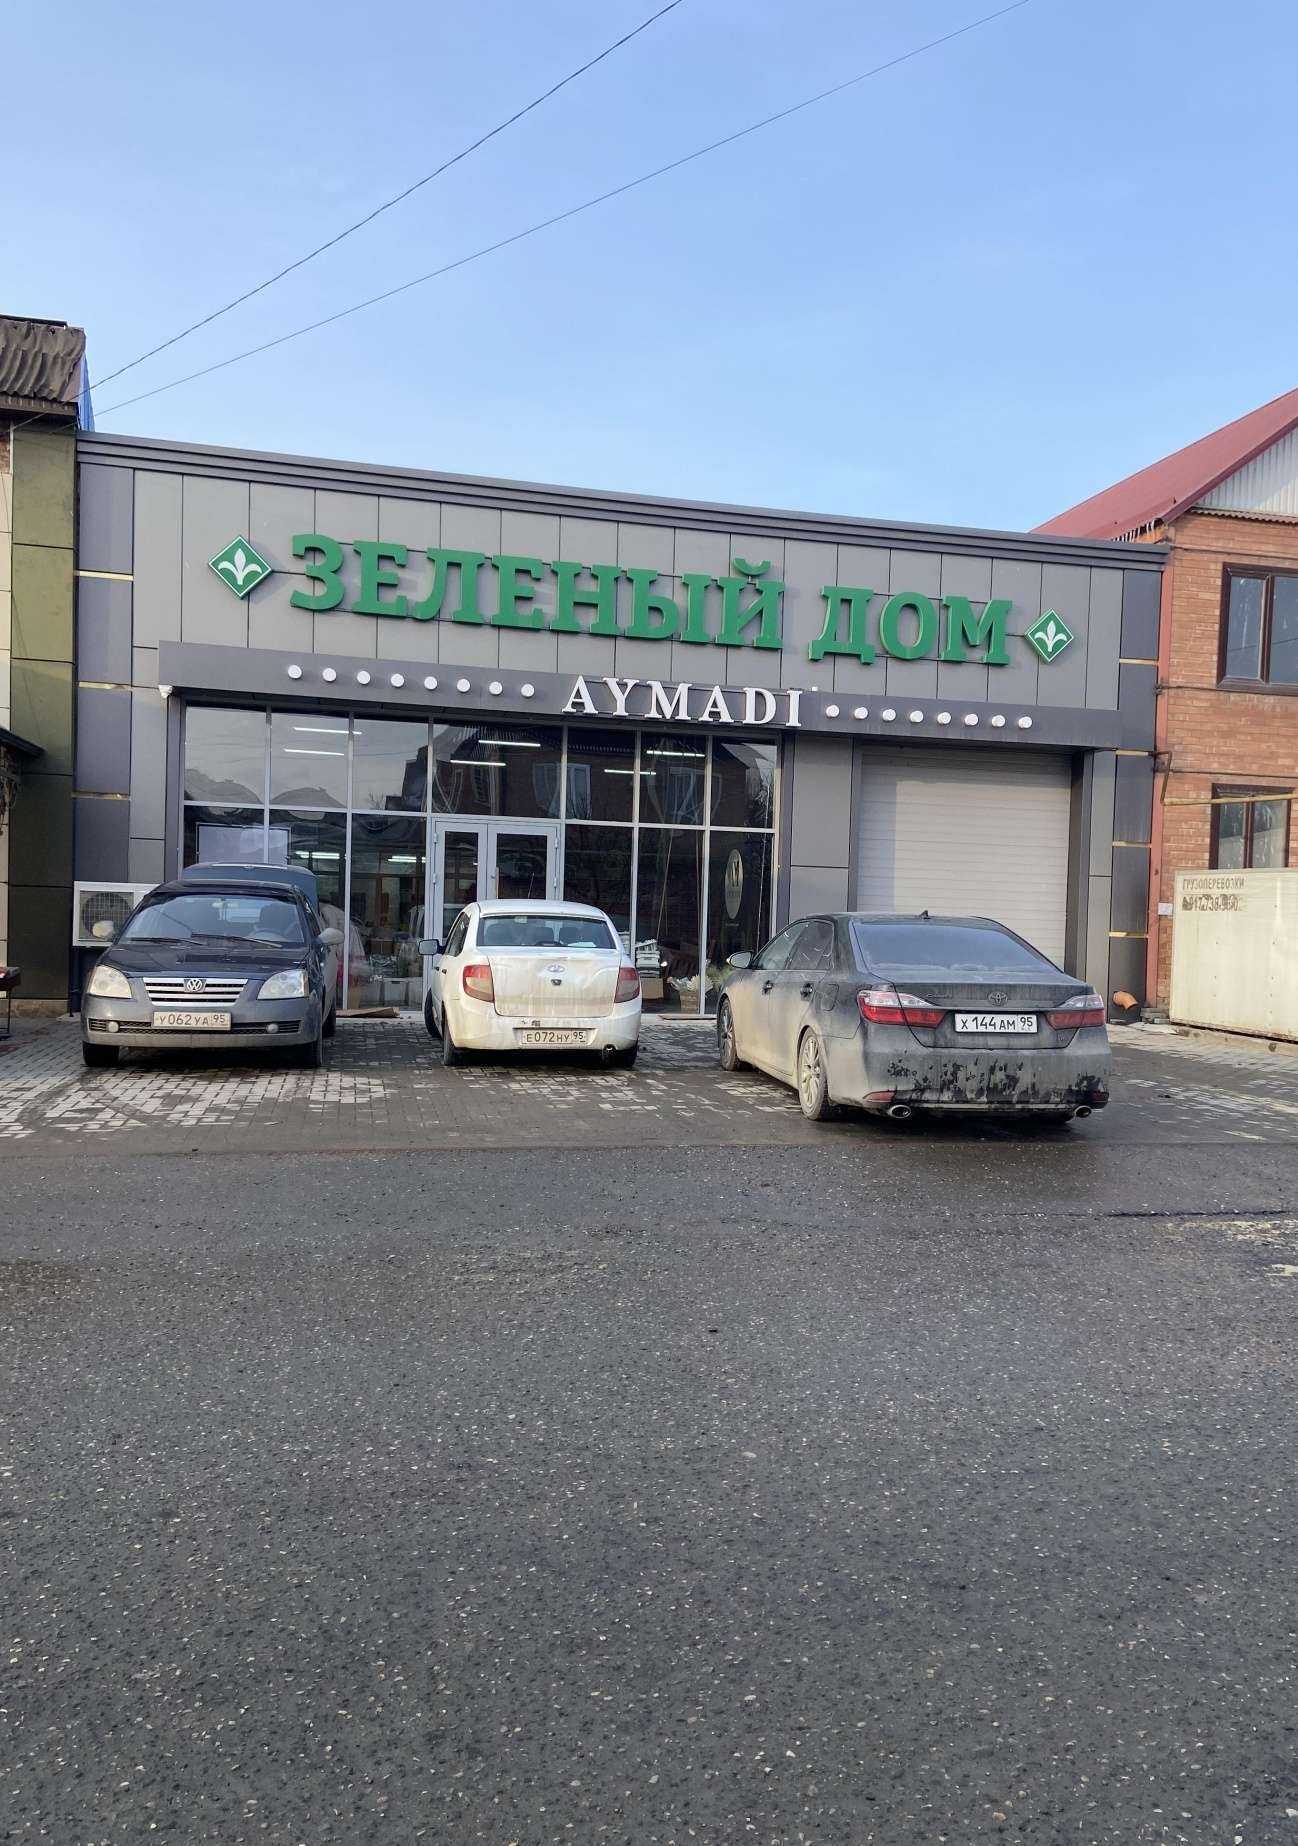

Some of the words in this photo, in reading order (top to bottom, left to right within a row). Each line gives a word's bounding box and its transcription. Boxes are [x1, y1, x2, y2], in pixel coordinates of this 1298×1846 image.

[289, 533, 786, 650] ЗЕЛЕНЫЙ
[808, 585, 1013, 666] ДОМ
[561, 675, 803, 727] AYMADI
